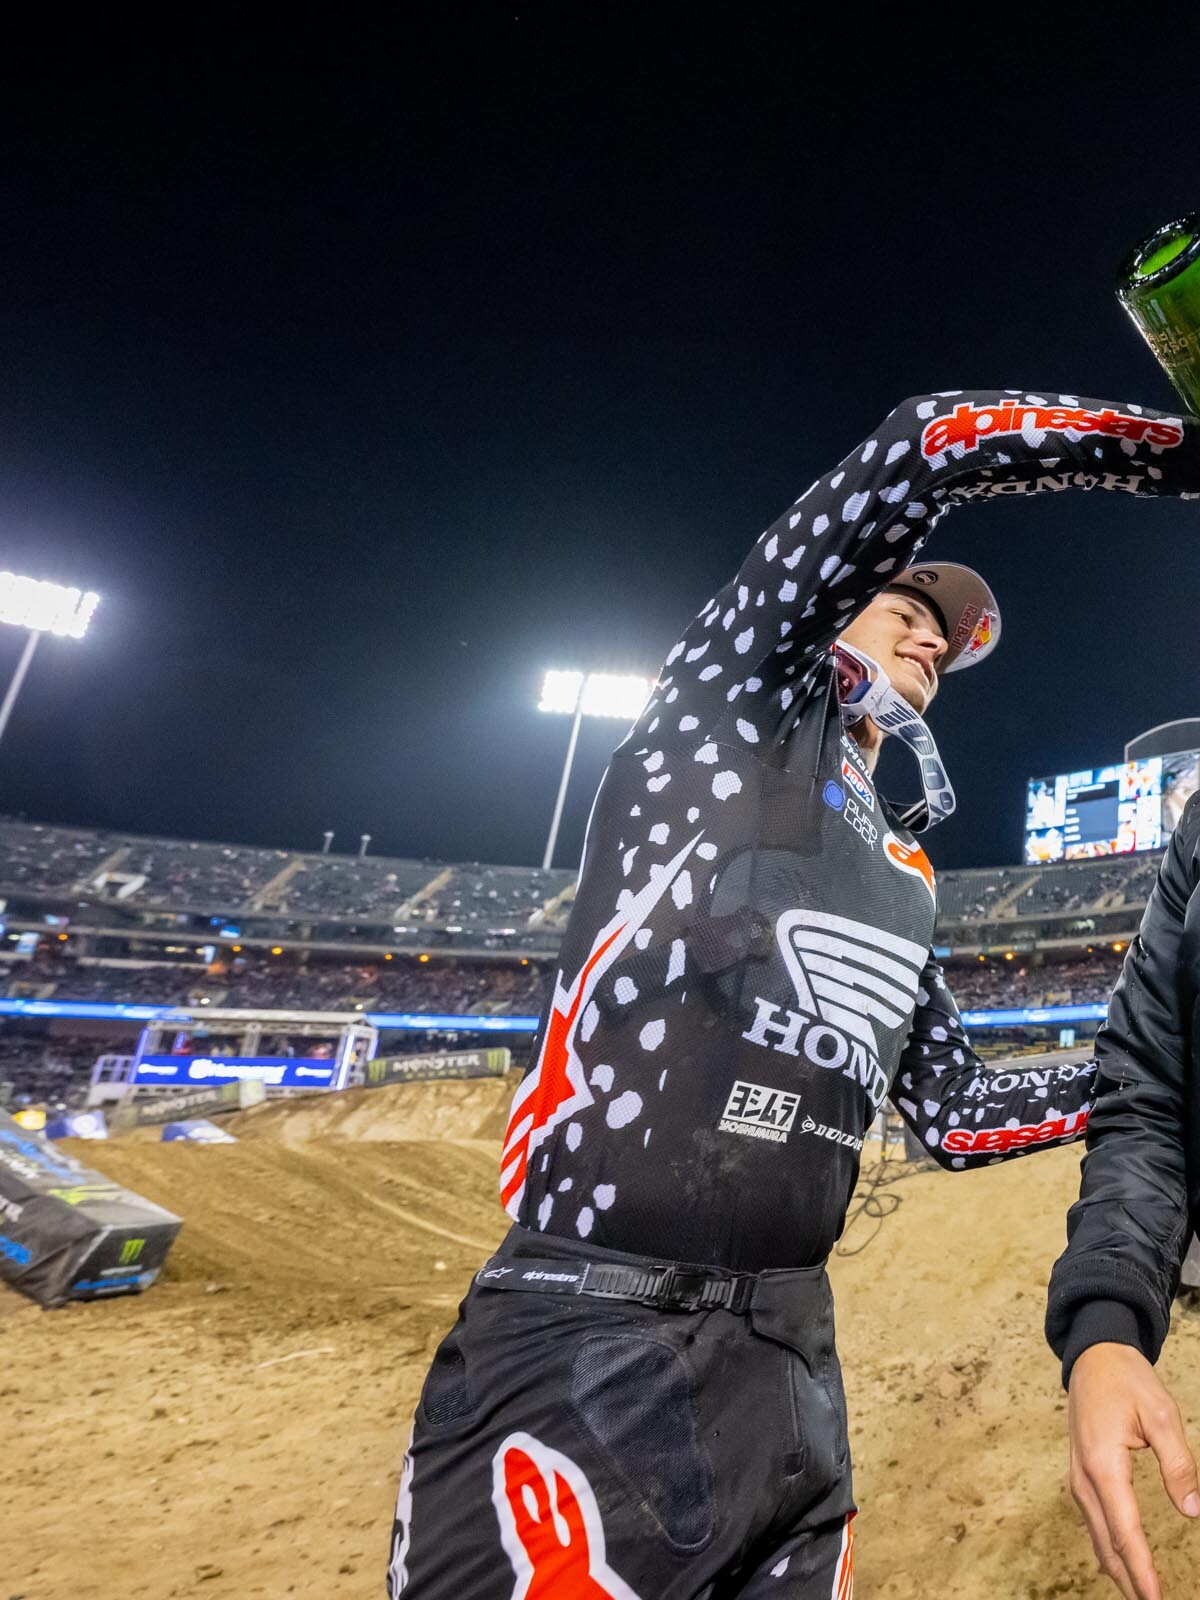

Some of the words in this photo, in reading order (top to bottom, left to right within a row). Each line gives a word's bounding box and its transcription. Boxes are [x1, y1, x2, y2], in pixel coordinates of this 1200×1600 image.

[922, 400, 1184, 458] alpinestars
[950, 470, 1145, 496] HONDA
[961, 603, 979, 629] Red
[951, 624, 970, 650] Bull
[845, 766, 871, 803] 100%
[844, 808, 876, 851] LOCK
[847, 798, 878, 841] QUAD
[718, 1119, 787, 1143] YOSHIMURA
